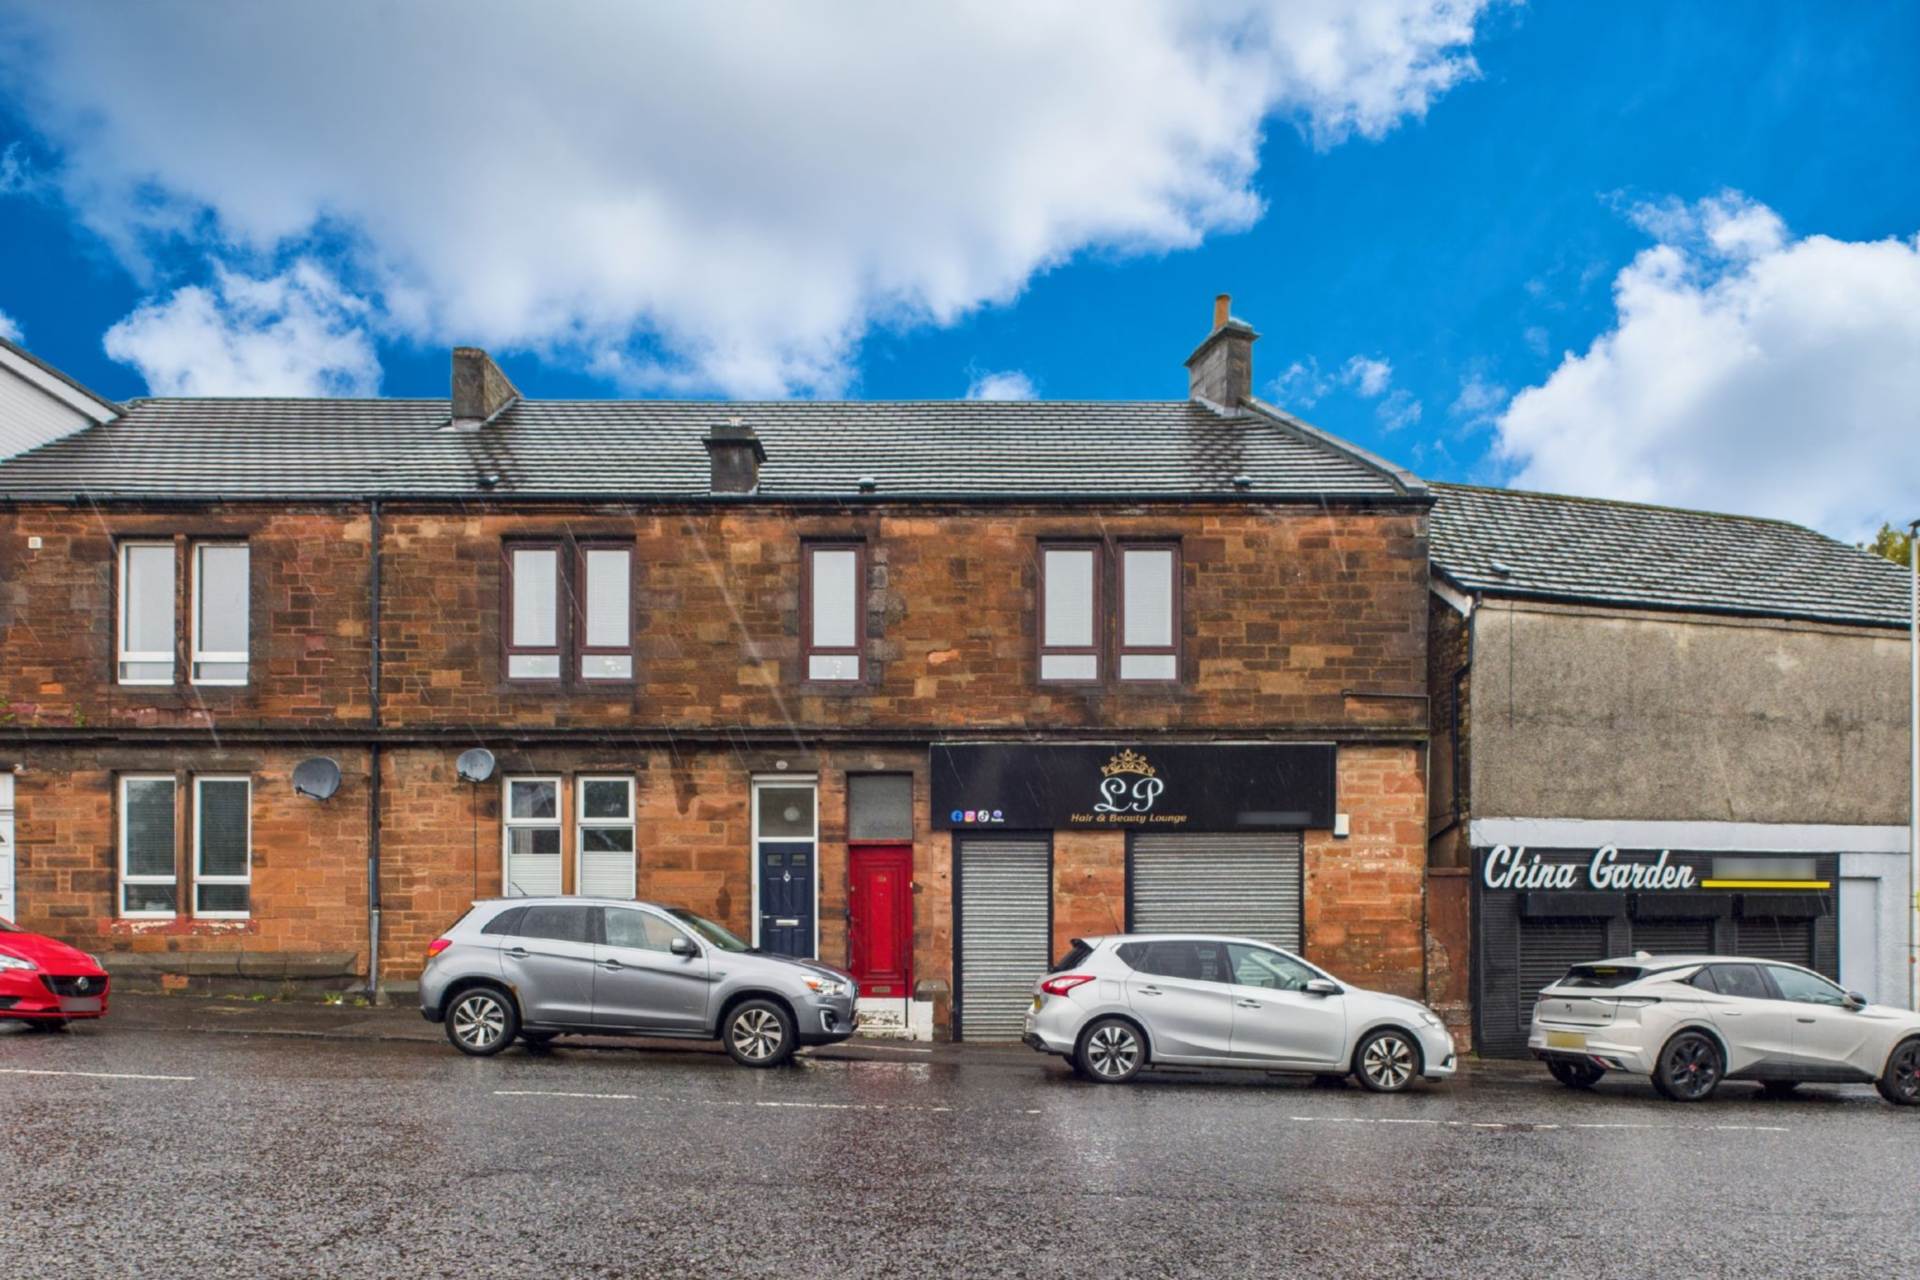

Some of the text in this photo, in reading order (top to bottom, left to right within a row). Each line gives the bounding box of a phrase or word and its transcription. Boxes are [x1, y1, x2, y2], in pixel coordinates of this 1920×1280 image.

[1093, 777, 1164, 812] LP
[1071, 813, 1187, 825] Hair & Beauty Lounge
[1484, 845, 1577, 889] China
[1589, 845, 1695, 889] Garden
